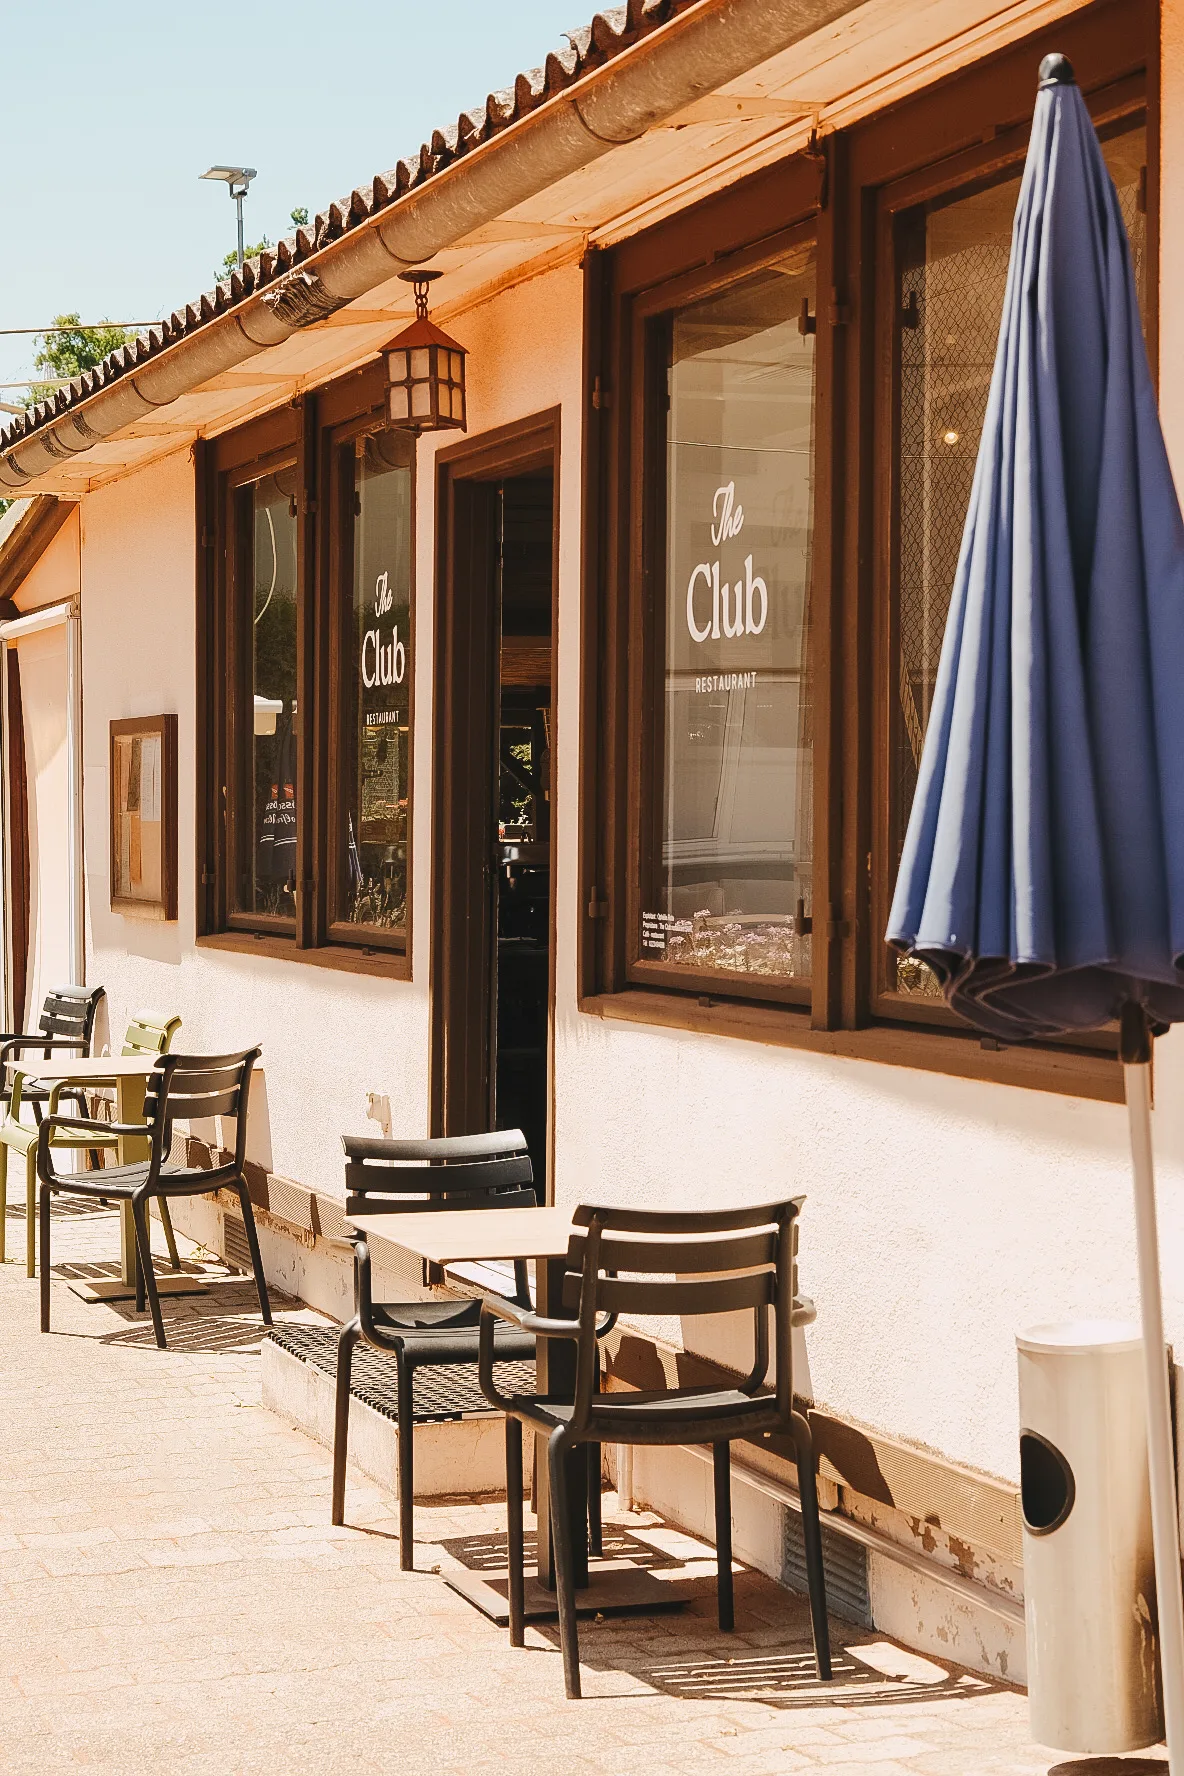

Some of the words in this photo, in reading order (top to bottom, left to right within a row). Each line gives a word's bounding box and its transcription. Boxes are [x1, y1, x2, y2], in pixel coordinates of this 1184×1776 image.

[711, 480, 744, 546] The
[374, 571, 393, 618] The
[686, 553, 768, 643] Club
[361, 625, 405, 688] Club
[695, 671, 757, 694] RESTAURANT
[366, 711, 400, 726] RESTAURANT
